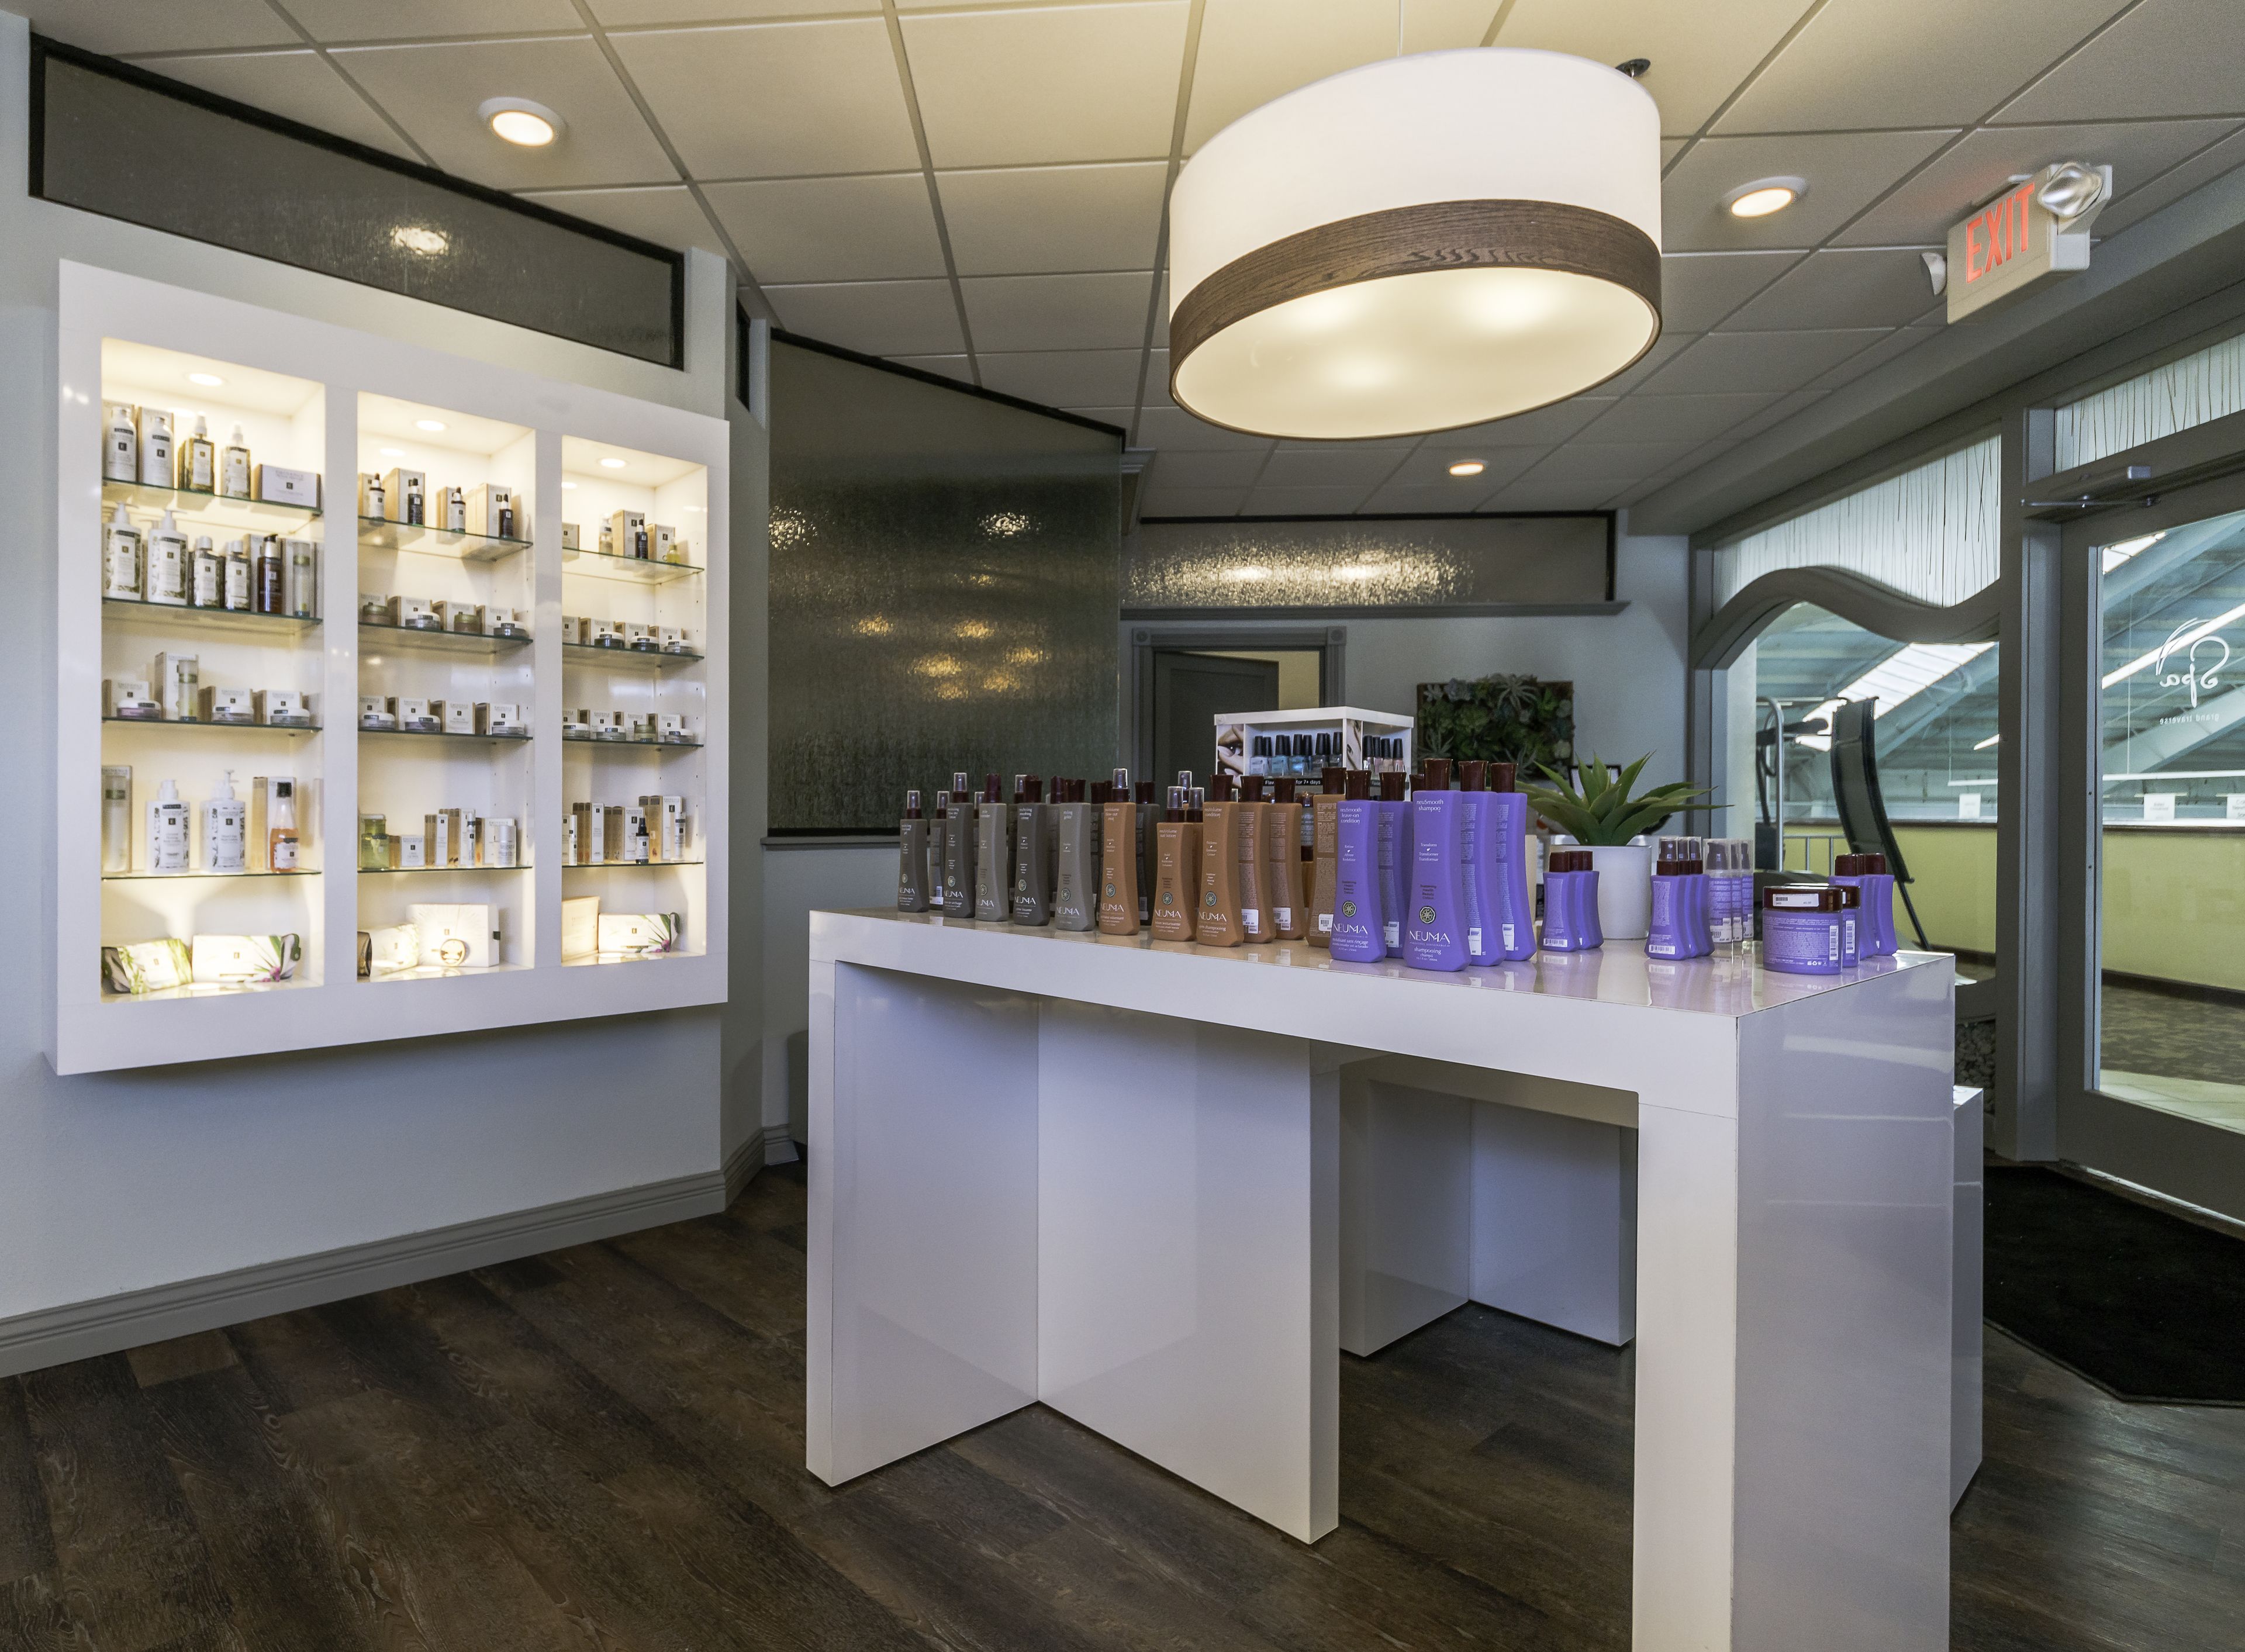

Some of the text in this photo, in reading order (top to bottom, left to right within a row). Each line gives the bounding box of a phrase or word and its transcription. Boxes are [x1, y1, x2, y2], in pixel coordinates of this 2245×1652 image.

[1966, 182, 2035, 284] EXIT
[1155, 909, 1182, 918] NEUMA
[1199, 911, 1227, 922] NEUMA
[1334, 923, 1368, 935] NEUMA
[1409, 931, 1450, 945] NEUMA
[1414, 946, 1442, 955] shampooing
